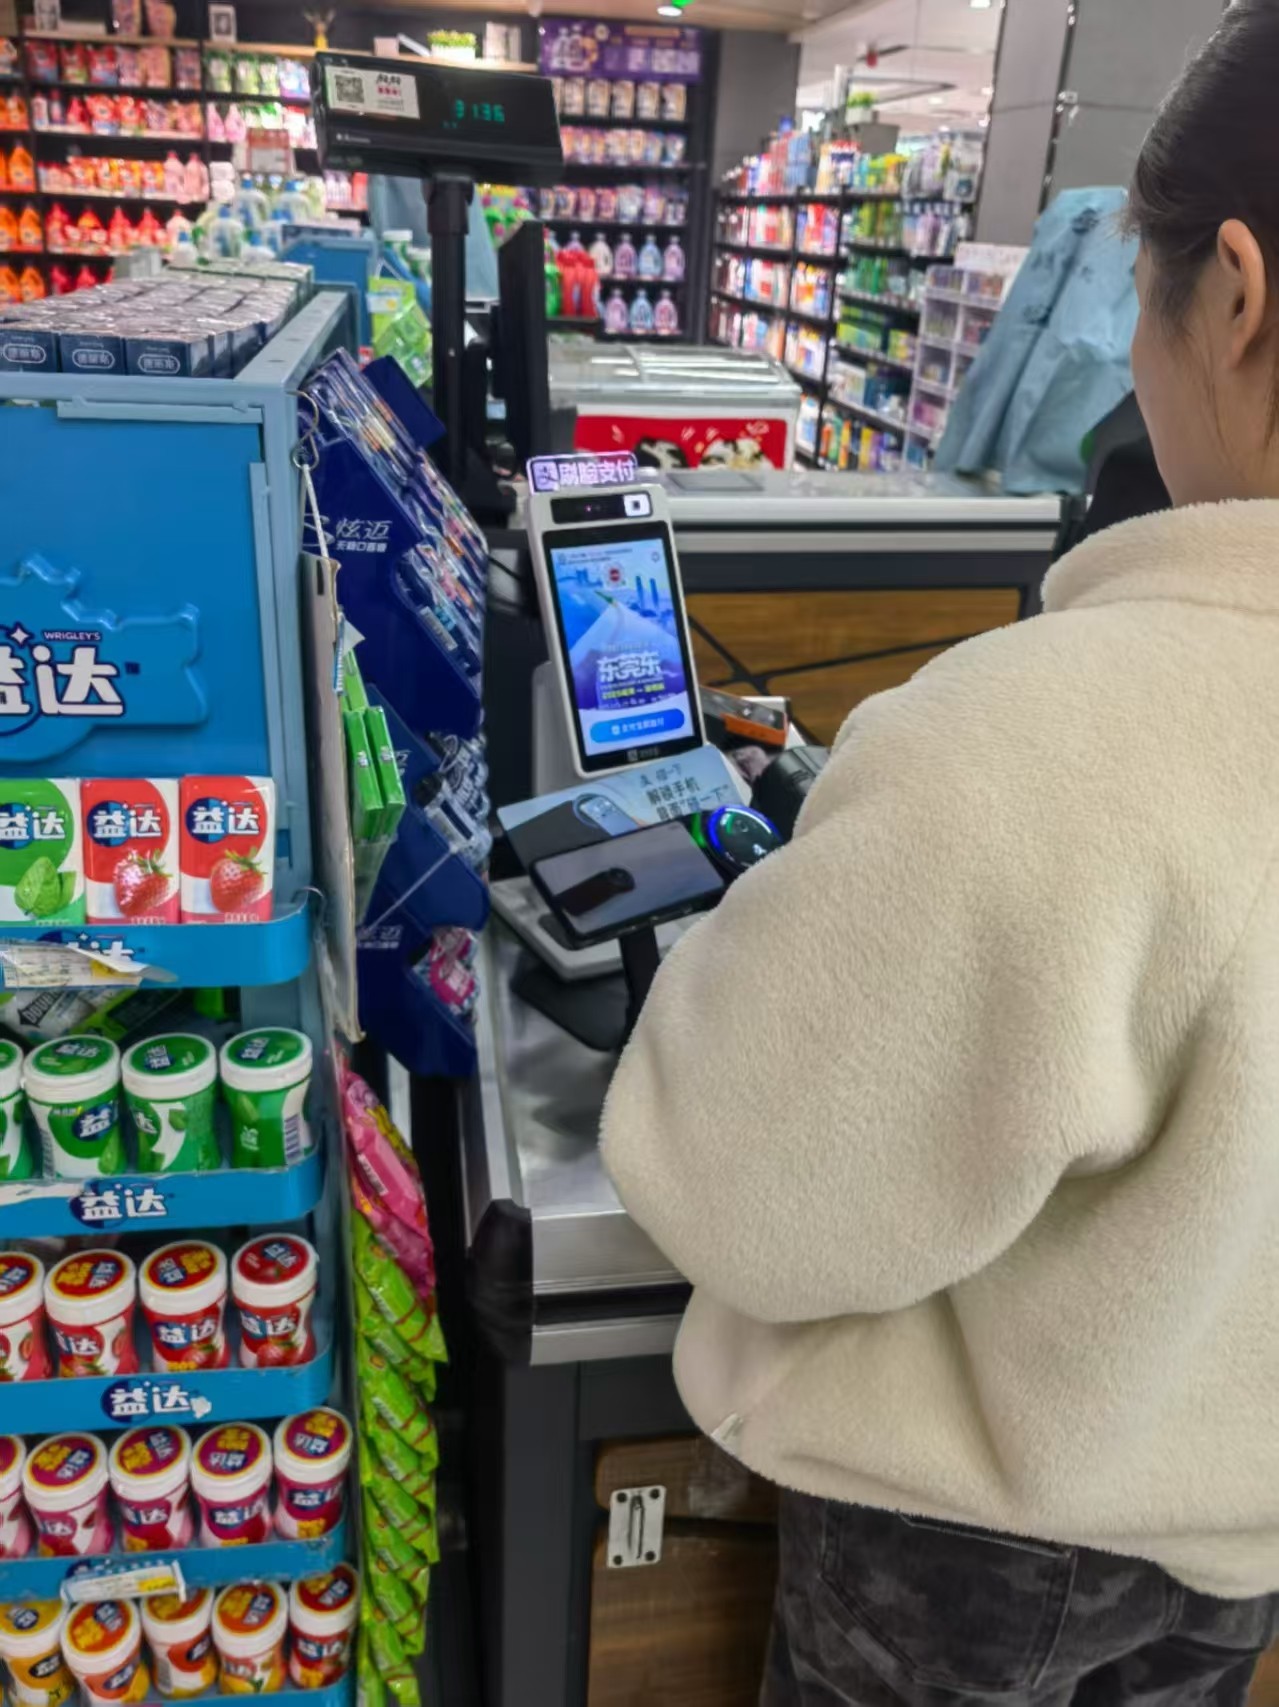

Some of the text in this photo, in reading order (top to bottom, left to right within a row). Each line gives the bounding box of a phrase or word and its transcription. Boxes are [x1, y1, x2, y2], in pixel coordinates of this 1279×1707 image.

[558, 459, 635, 485] 刷脸支付
[336, 518, 393, 540] 炫迈
[43, 631, 101, 641] WRIGLEY'S
[93, 810, 162, 837] 益达
[193, 807, 259, 834] 益达
[80, 1186, 167, 1220] 益达
[157, 1318, 215, 1344] 益达
[110, 1385, 190, 1417] 益达
